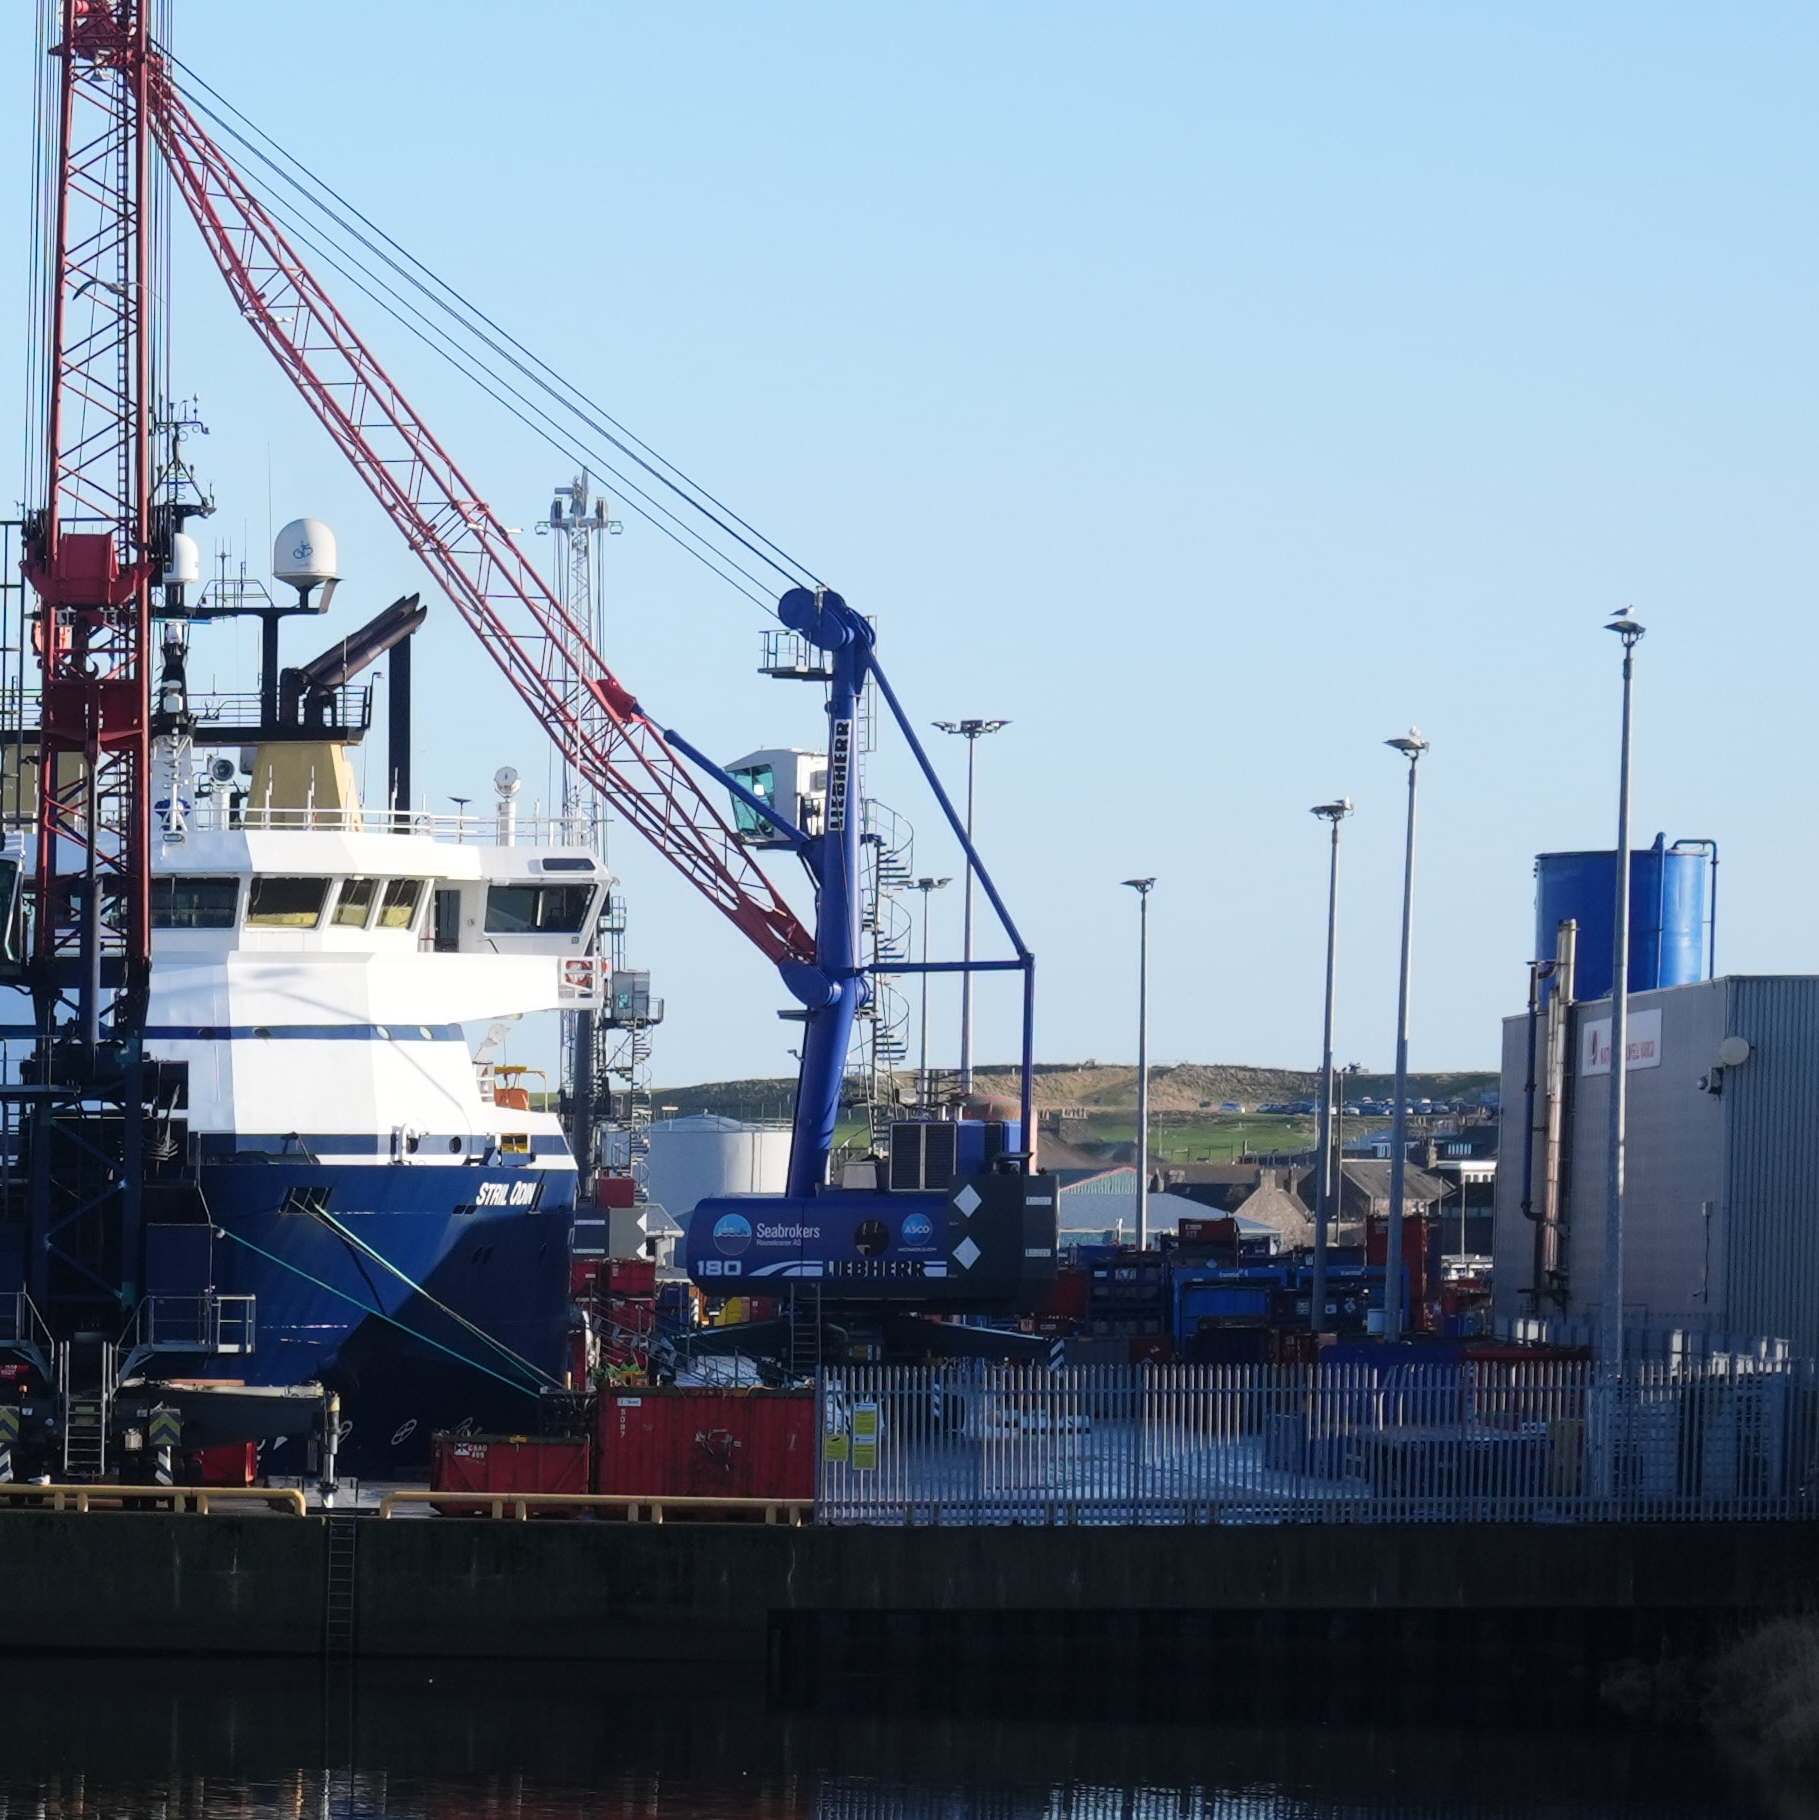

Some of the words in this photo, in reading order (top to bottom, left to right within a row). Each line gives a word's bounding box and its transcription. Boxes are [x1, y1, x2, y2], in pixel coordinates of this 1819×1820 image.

[830, 722, 850, 829] LIEBHERR
[476, 1182, 510, 1206] STRIL
[756, 1223, 821, 1239] Seabrokers
[904, 1225, 930, 1234] ASCO
[697, 1260, 742, 1276] 180
[825, 1260, 925, 1277] LIEBHERR
